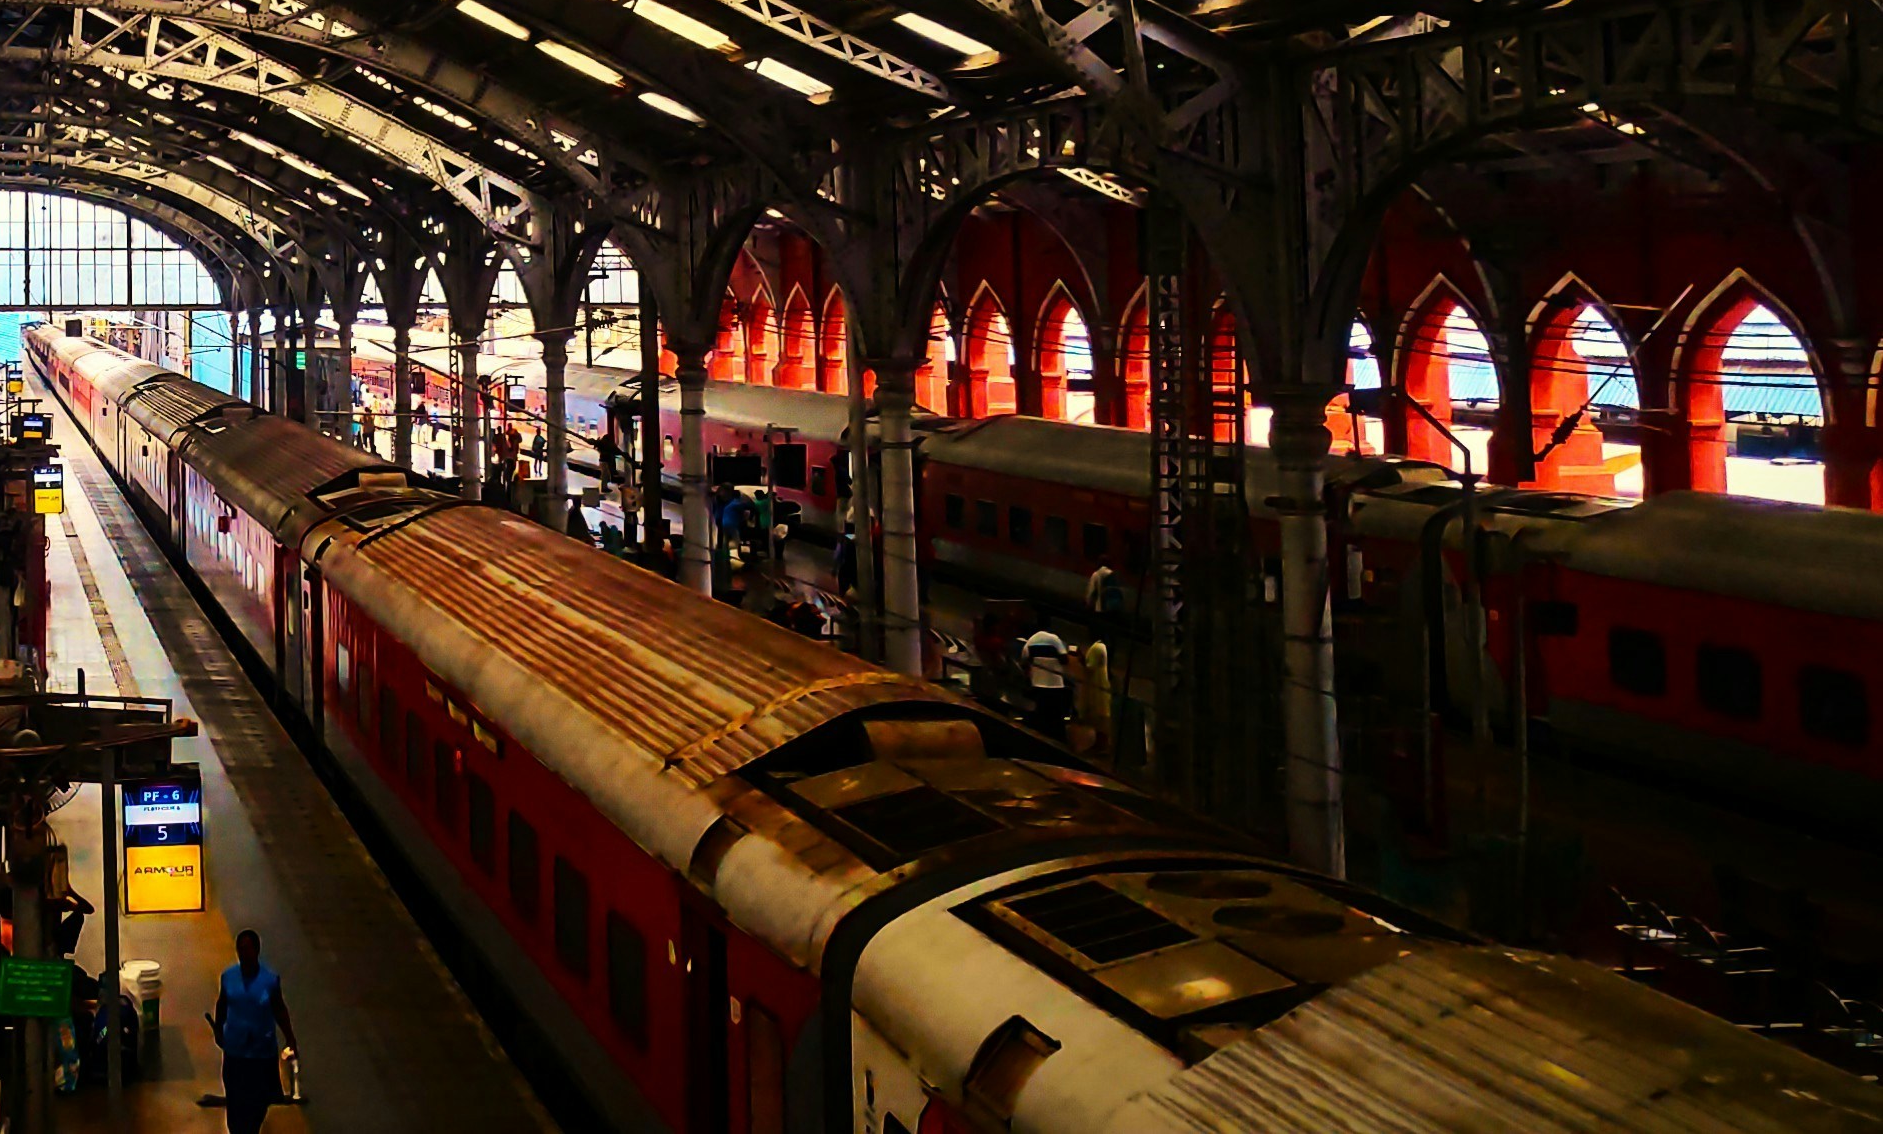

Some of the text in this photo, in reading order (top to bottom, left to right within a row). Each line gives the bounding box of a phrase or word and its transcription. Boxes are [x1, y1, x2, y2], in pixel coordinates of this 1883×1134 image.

[144, 791, 159, 802] PF
[172, 790, 180, 800] 6
[158, 826, 168, 841] 5
